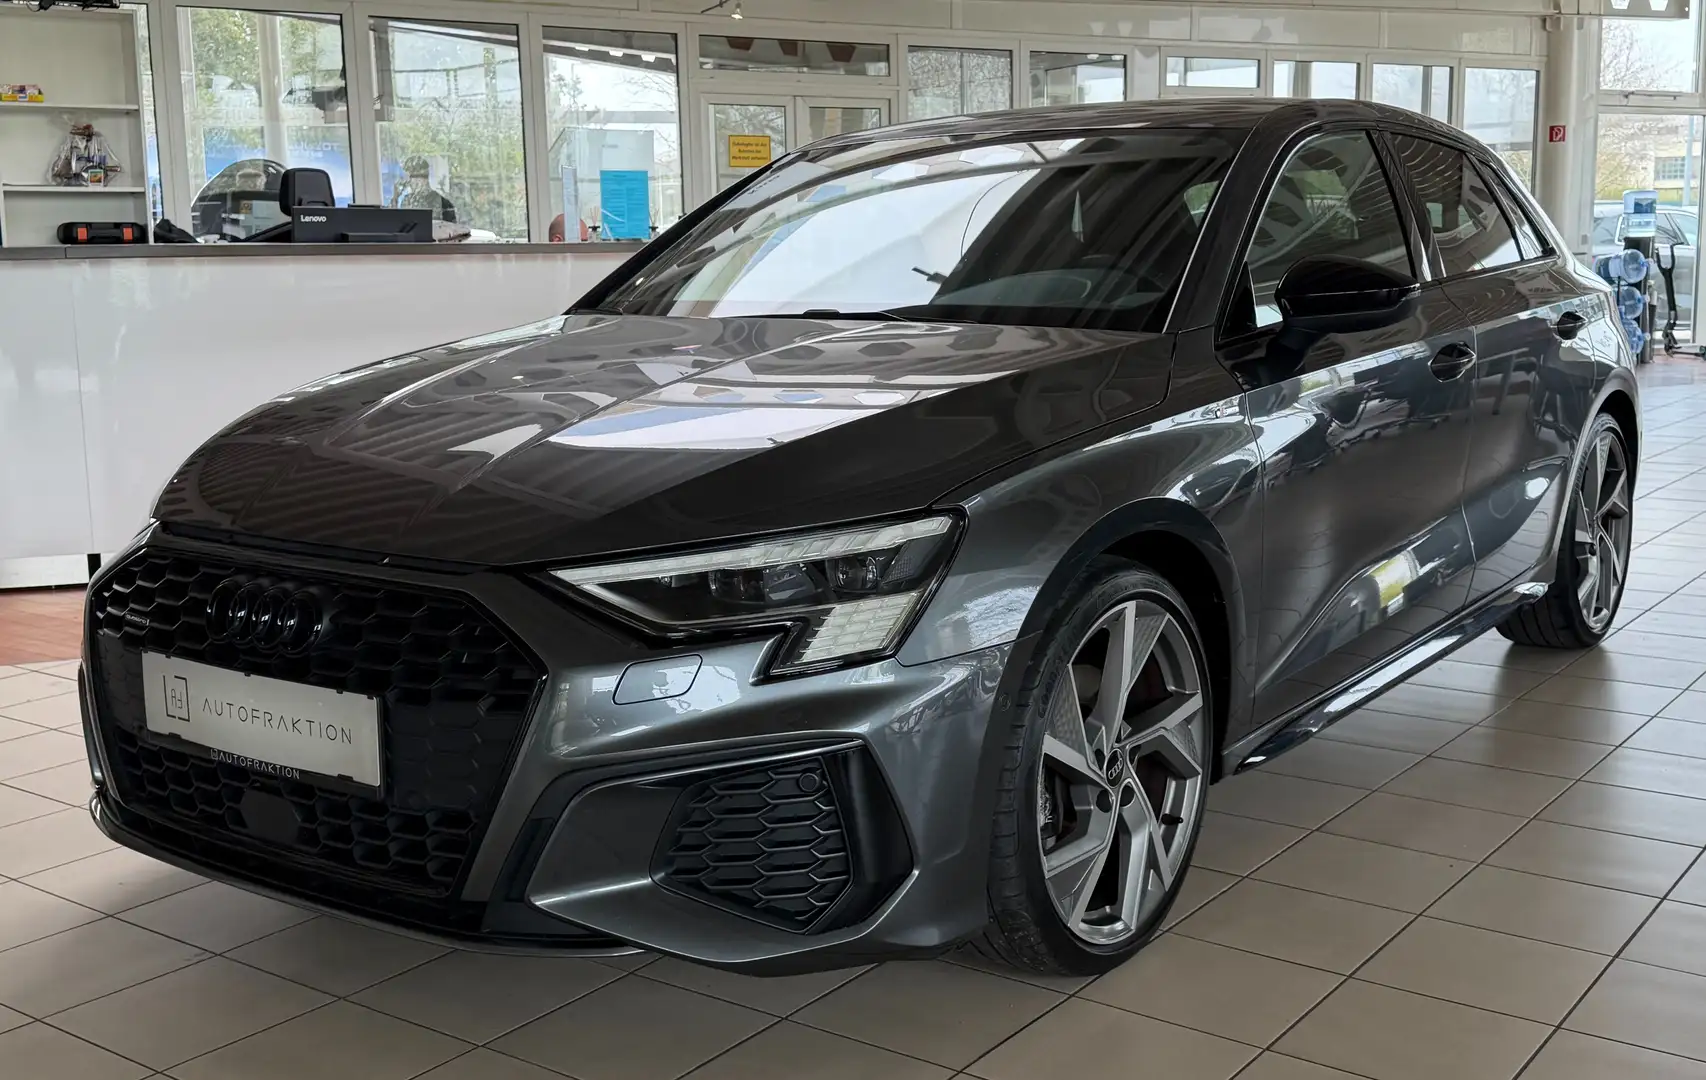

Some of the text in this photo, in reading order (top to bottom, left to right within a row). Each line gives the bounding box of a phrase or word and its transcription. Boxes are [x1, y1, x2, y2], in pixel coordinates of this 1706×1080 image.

[300, 214, 327, 222] Lenovo
[202, 697, 352, 744] AUTOFRAKTION
[219, 752, 300, 780] AUTOFRAKTION
